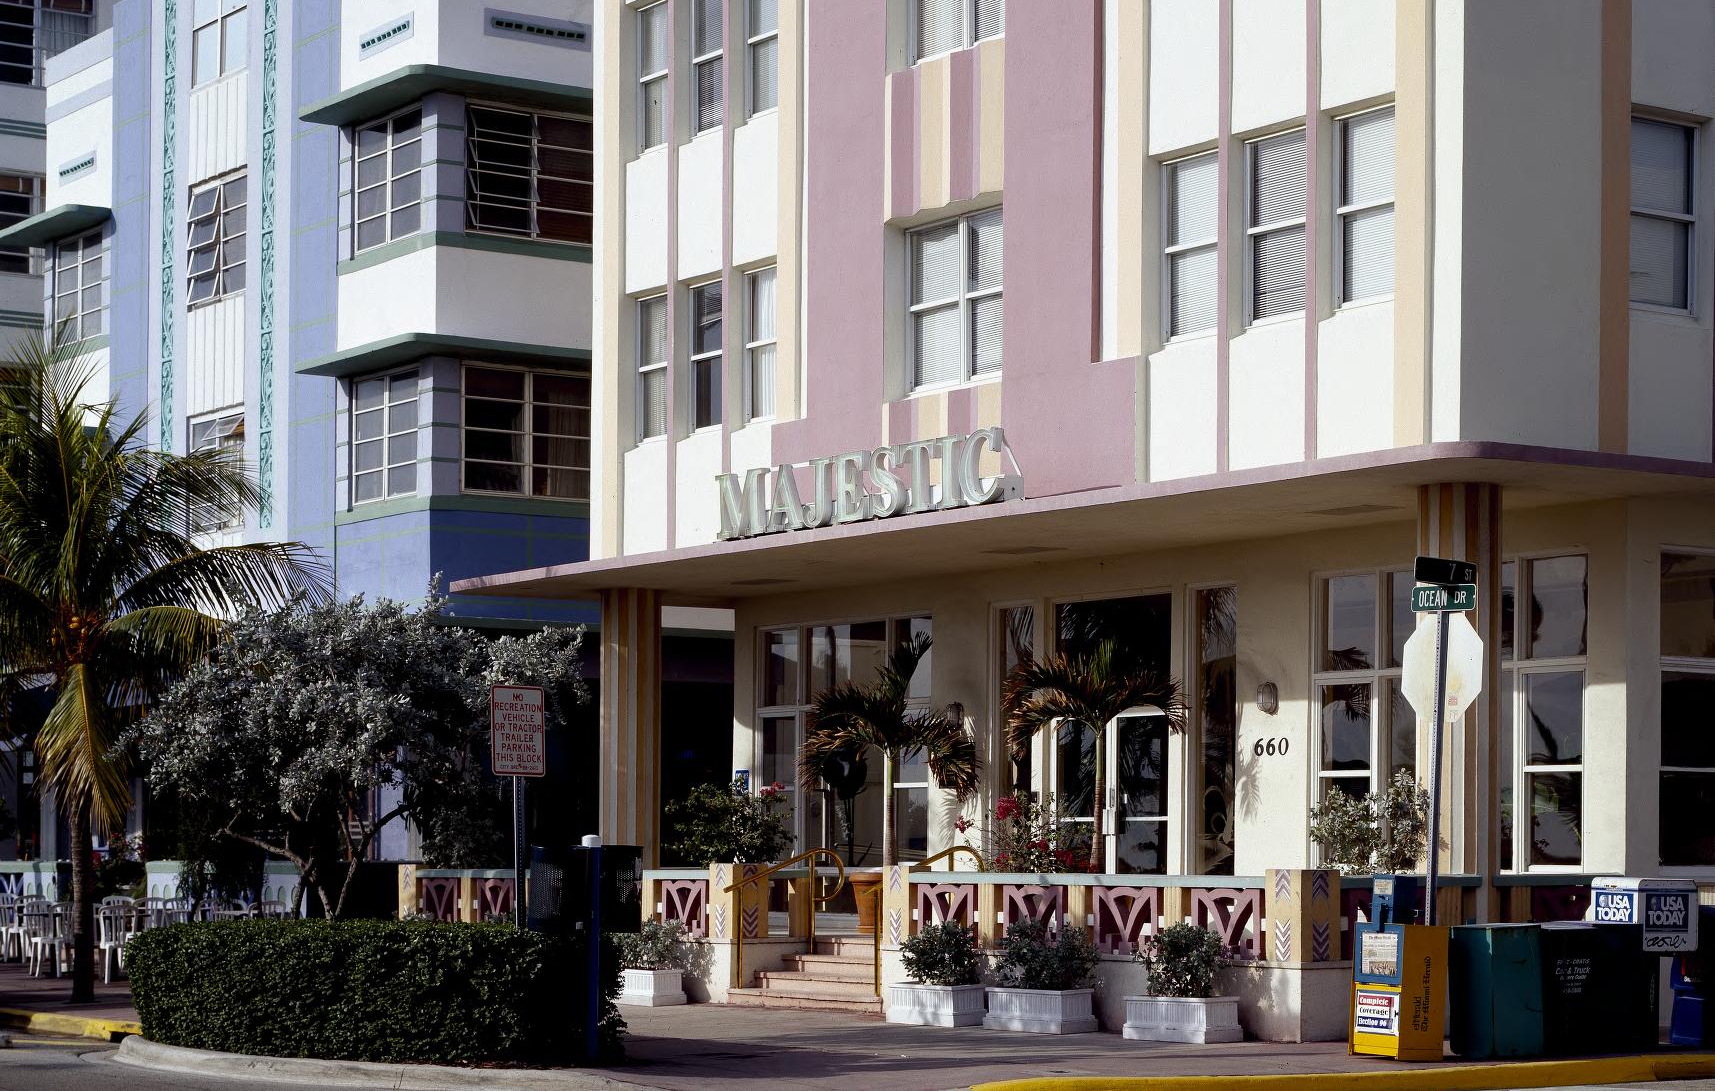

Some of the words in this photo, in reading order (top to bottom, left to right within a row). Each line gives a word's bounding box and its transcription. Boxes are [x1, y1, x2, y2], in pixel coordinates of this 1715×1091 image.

[715, 427, 1006, 540] MAJESTIC
[1448, 563, 1457, 582] 7
[1464, 569, 1473, 582] ST
[1418, 589, 1448, 608] OCEAN
[1453, 590, 1467, 604] DR
[512, 693, 524, 702] NO
[494, 702, 542, 713] RECREATION
[502, 713, 535, 723] VEHICLE
[495, 723, 506, 732] OR
[509, 723, 543, 734] TRACTOR
[501, 733, 534, 743] TRAILER
[501, 743, 536, 753] PARKING
[1254, 737, 1289, 757] 660
[496, 753, 514, 762] THIS
[516, 753, 542, 763] BLOCK
[1609, 894, 1631, 909] USA
[1660, 896, 1685, 911] USA
[1597, 907, 1632, 922] TODAY
[1647, 910, 1687, 926] TODAY
[1360, 996, 1389, 1006] Complete
[1359, 1006, 1389, 1016] Coverage
[1358, 1017, 1379, 1026] Election
